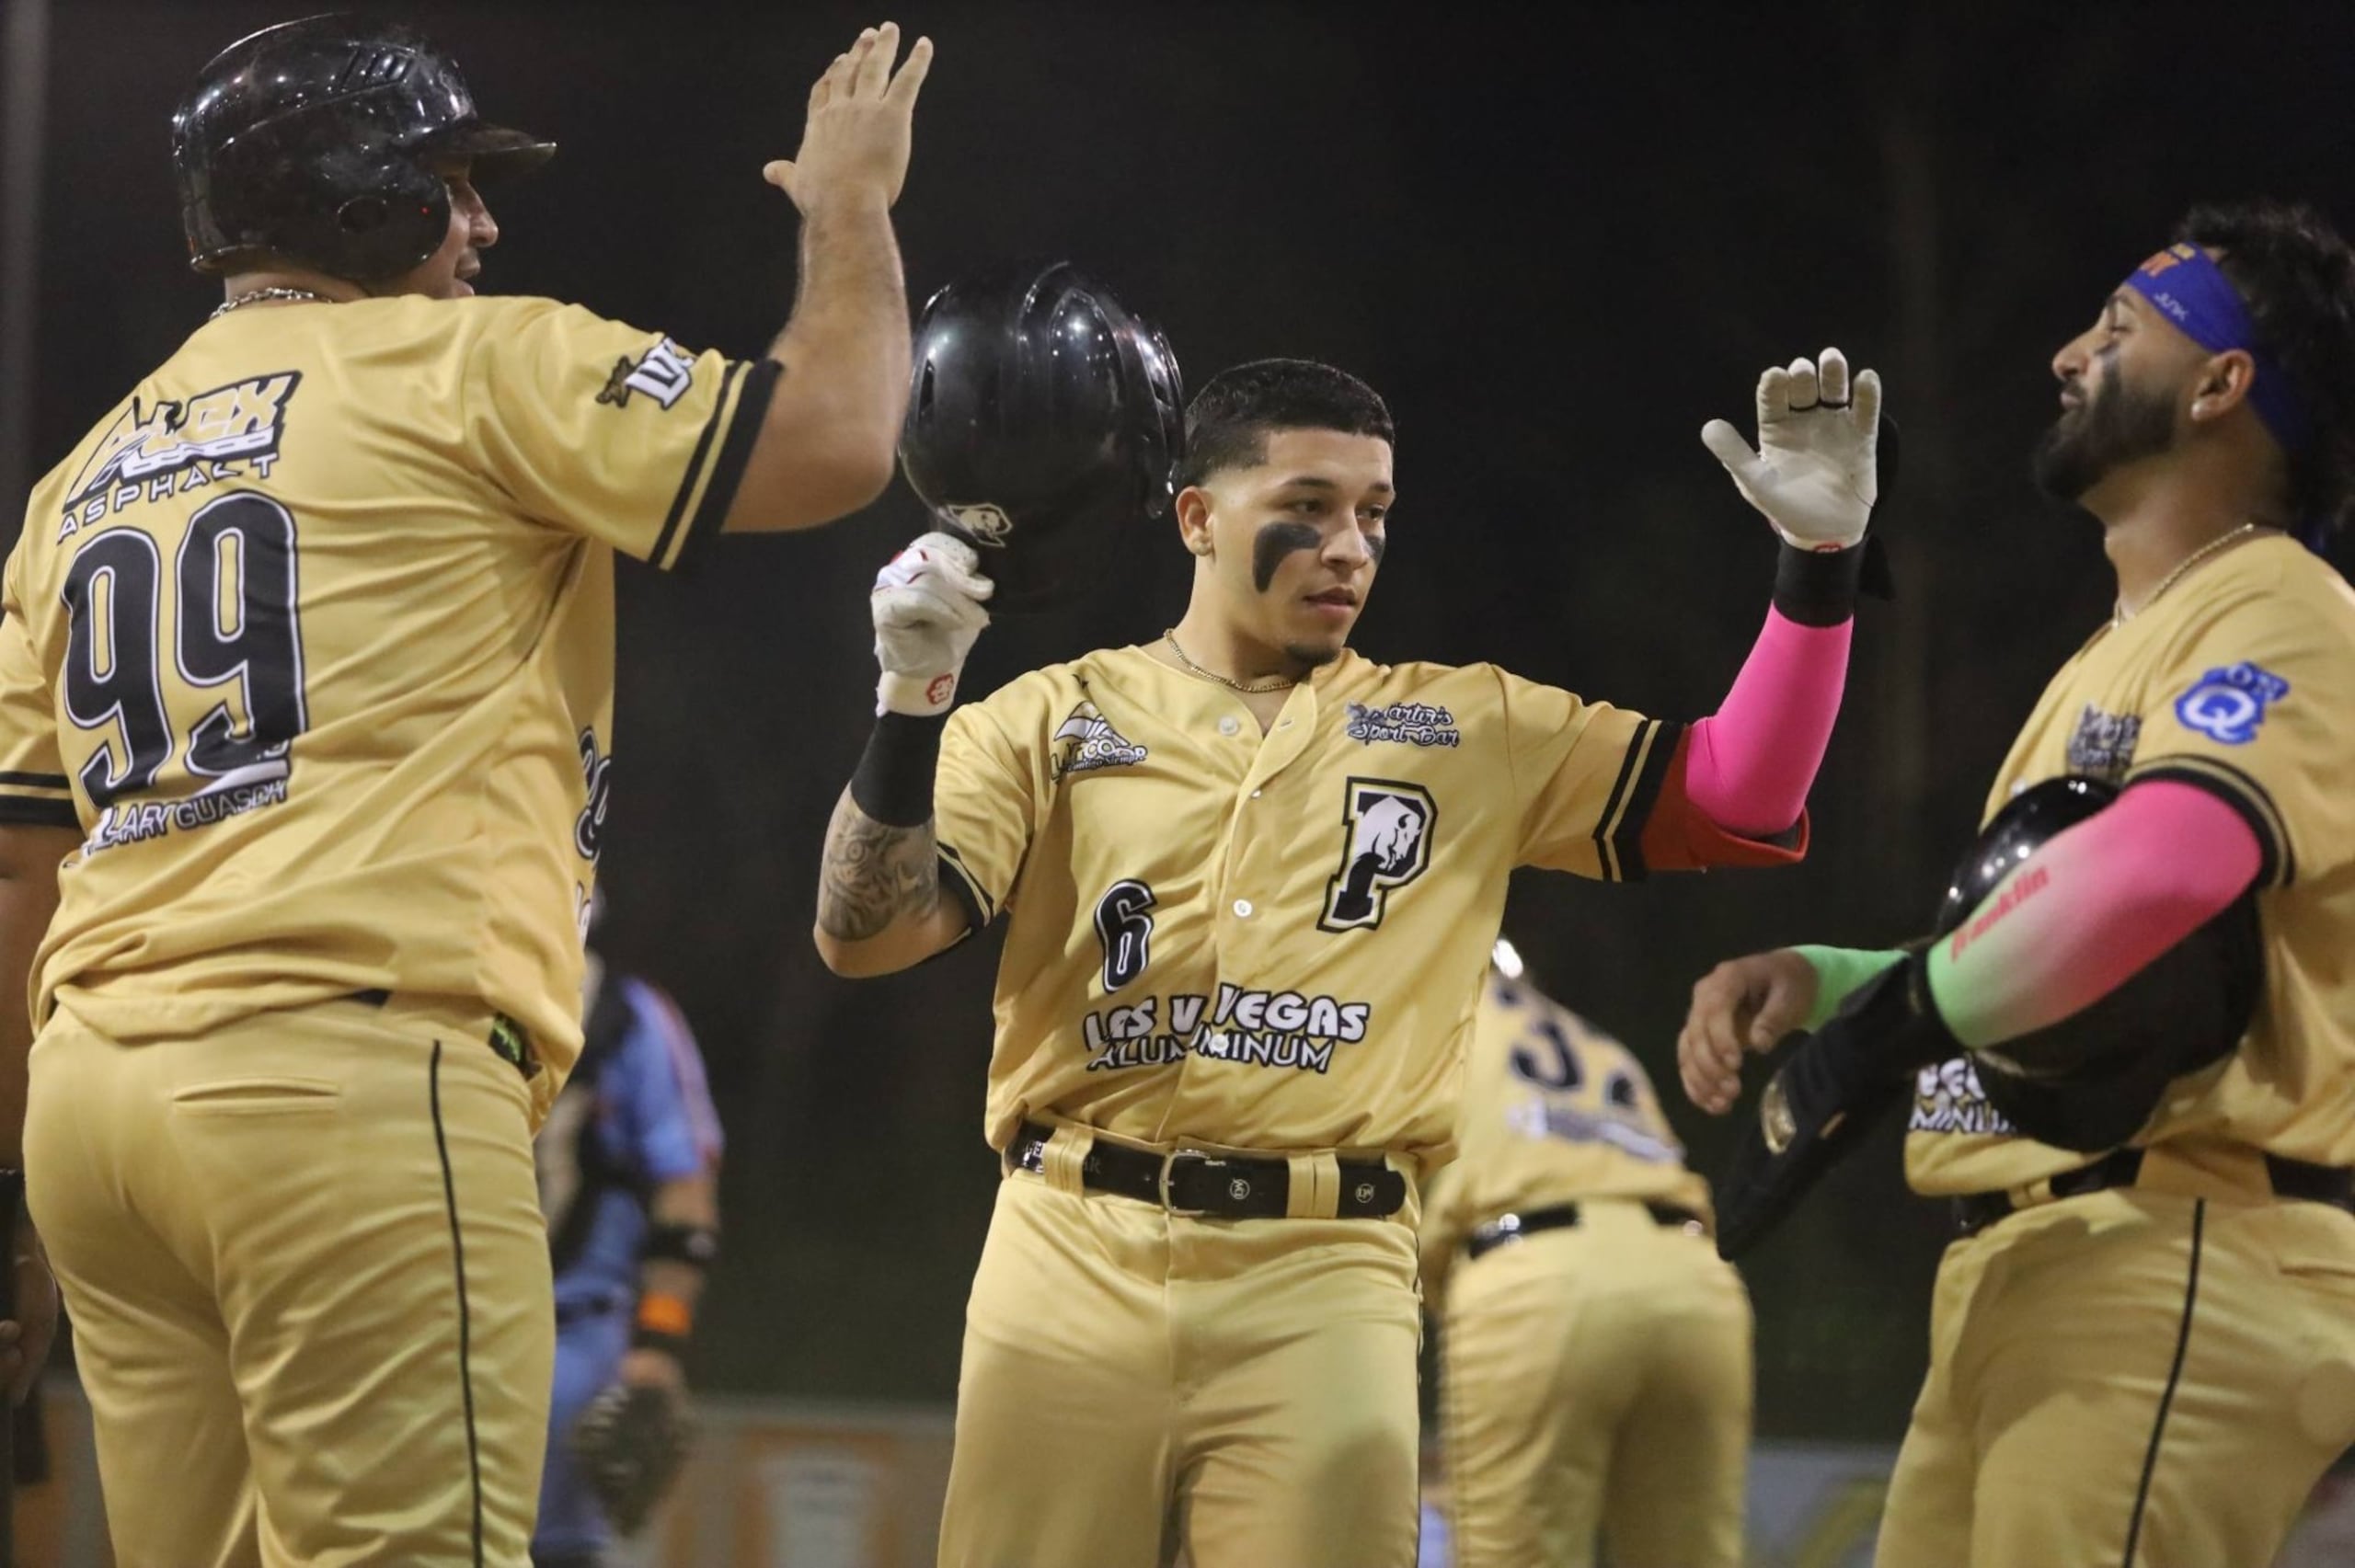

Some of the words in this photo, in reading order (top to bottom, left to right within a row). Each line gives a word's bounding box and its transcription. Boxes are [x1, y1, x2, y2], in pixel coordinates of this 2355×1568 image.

[61, 489, 309, 813] 99
[1410, 723, 1460, 749] Bar
[1316, 775, 1439, 933] P
[1093, 878, 1157, 993] 6
[1084, 995, 1157, 1052] LAS
